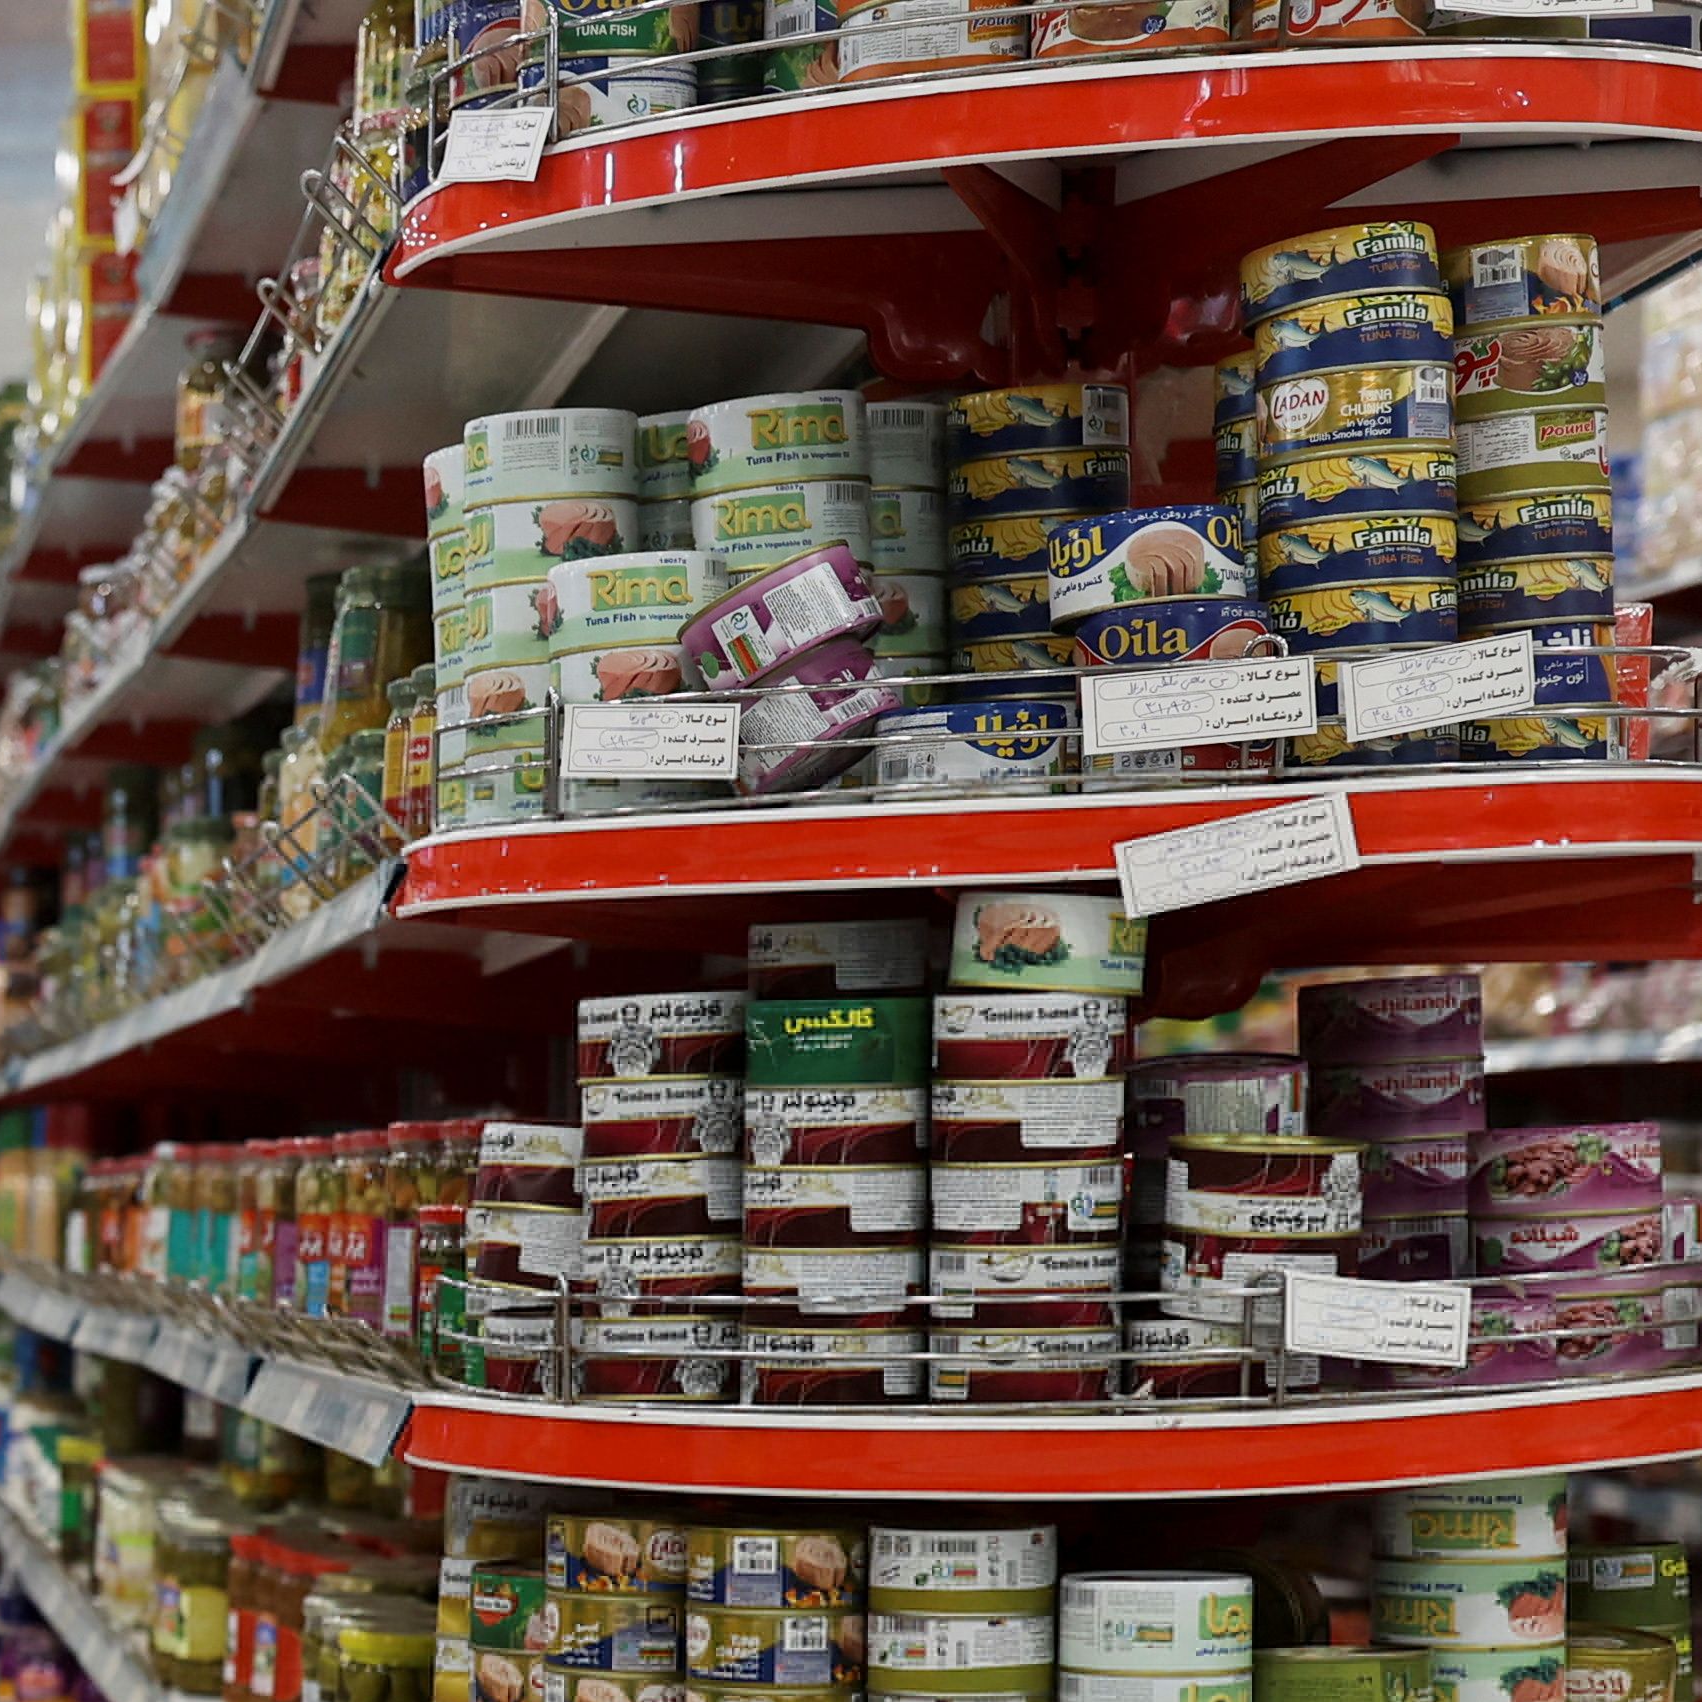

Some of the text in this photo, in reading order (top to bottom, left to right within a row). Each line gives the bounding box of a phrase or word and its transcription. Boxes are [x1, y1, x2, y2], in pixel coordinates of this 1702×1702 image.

[576, 24, 637, 37] TUNA FISH
[1355, 233, 1425, 257] Famila
[1345, 306, 1427, 326] Famila
[1359, 329, 1420, 343] TUNA FISH
[1359, 388, 1393, 401] TUNA
[1273, 389, 1325, 418] LADAN
[746, 405, 849, 449] Rima
[1332, 428, 1363, 440] Smoke
[1366, 426, 1392, 437] Flavor
[746, 455, 774, 468] Tuna
[776, 451, 799, 465] Fish
[711, 501, 812, 537] Rima
[1520, 501, 1594, 523] Famila
[1207, 515, 1243, 552] Oil
[1355, 527, 1431, 548] Famila
[732, 540, 753, 553] Fish
[1366, 553, 1424, 566] TUNA FISH
[586, 568, 693, 608] Rima
[585, 615, 610, 627] Tuna
[613, 611, 636, 624] Fish
[1099, 621, 1190, 659] Oila
[1275, 667, 1300, 681] نوع
[1260, 691, 1302, 703] مصرف
[1487, 686, 1524, 701] فروشگاه
[706, 713, 727, 726] نوع
[1255, 709, 1303, 725] فروشگاه
[689, 735, 726, 746] مصرف
[688, 755, 725, 767] فروشگاه
